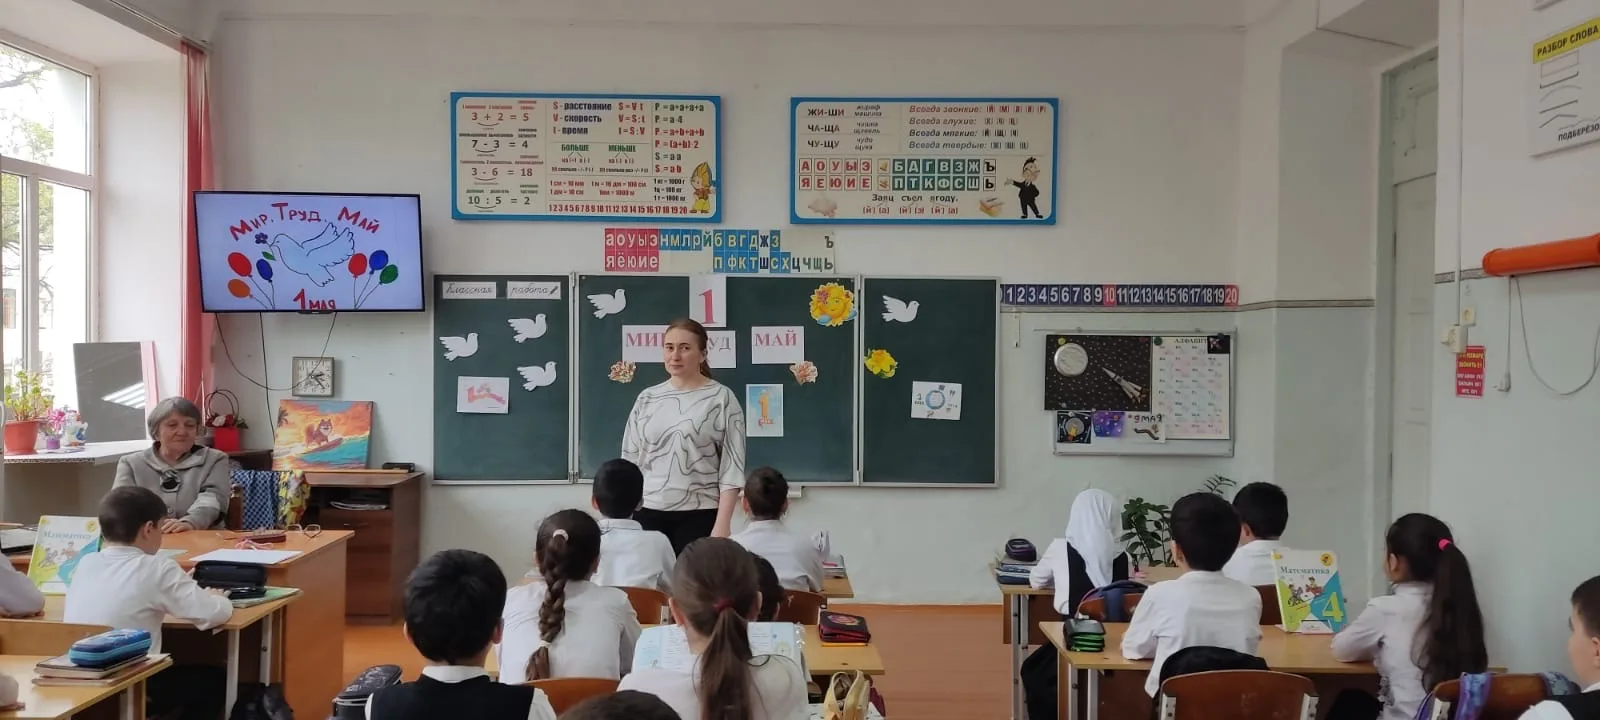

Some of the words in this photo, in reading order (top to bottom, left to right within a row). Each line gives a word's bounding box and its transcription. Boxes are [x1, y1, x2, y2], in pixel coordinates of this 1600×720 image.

[1537, 38, 1567, 56] РАЗБОР
[1570, 25, 1598, 44] СЛОВА
[523, 113, 528, 121] 5
[808, 124, 840, 133] ЧА-ЩА
[472, 140, 477, 148] 7
[494, 140, 499, 148] 3
[808, 140, 839, 149] ЧУ-ЩУ
[521, 168, 532, 176] 18
[802, 161, 809, 171] А
[817, 161, 825, 171] О
[832, 161, 840, 170] У
[846, 162, 856, 171] Ы
[862, 162, 870, 171] Э
[895, 162, 903, 171] Б
[926, 162, 932, 171] Г
[940, 162, 948, 171] В
[955, 162, 963, 171] З
[969, 162, 979, 172] Ж
[985, 162, 994, 171] Ъ
[802, 178, 809, 187] Я
[817, 179, 824, 188] Е
[831, 178, 841, 187] Ю
[847, 178, 855, 187] И
[863, 179, 870, 188] Е
[895, 178, 903, 188] П
[909, 178, 917, 188] Т
[925, 178, 933, 188] К
[939, 178, 949, 188] Ф
[954, 178, 963, 188] С
[968, 178, 978, 188] Ш
[986, 179, 993, 188] Ь
[293, 289, 305, 310] 1
[1007, 287, 1013, 302] 1
[1017, 287, 1025, 302] 2
[1028, 288, 1035, 302] 3
[1039, 288, 1047, 302] 4
[1051, 288, 1058, 302] 5
[1062, 288, 1069, 302] 6
[1073, 288, 1080, 302] 7
[1084, 288, 1091, 302] 8
[1095, 288, 1102, 302] 9
[1105, 288, 1114, 302] 10
[1117, 288, 1127, 302] 11
[1129, 288, 1139, 302] 12
[1141, 288, 1151, 302] 13
[1153, 288, 1164, 302] 14
[1165, 288, 1176, 302] 15
[1178, 288, 1188, 302] 16
[1190, 288, 1200, 302] 17
[1202, 288, 1212, 302] 18
[1214, 288, 1224, 302] 19
[1226, 288, 1237, 302] 20
[698, 289, 716, 324] 1
[755, 330, 797, 346] МАЙ
[708, 337, 730, 352] УД
[1280, 566, 1330, 574] Математика
[1322, 592, 1344, 622] 4
